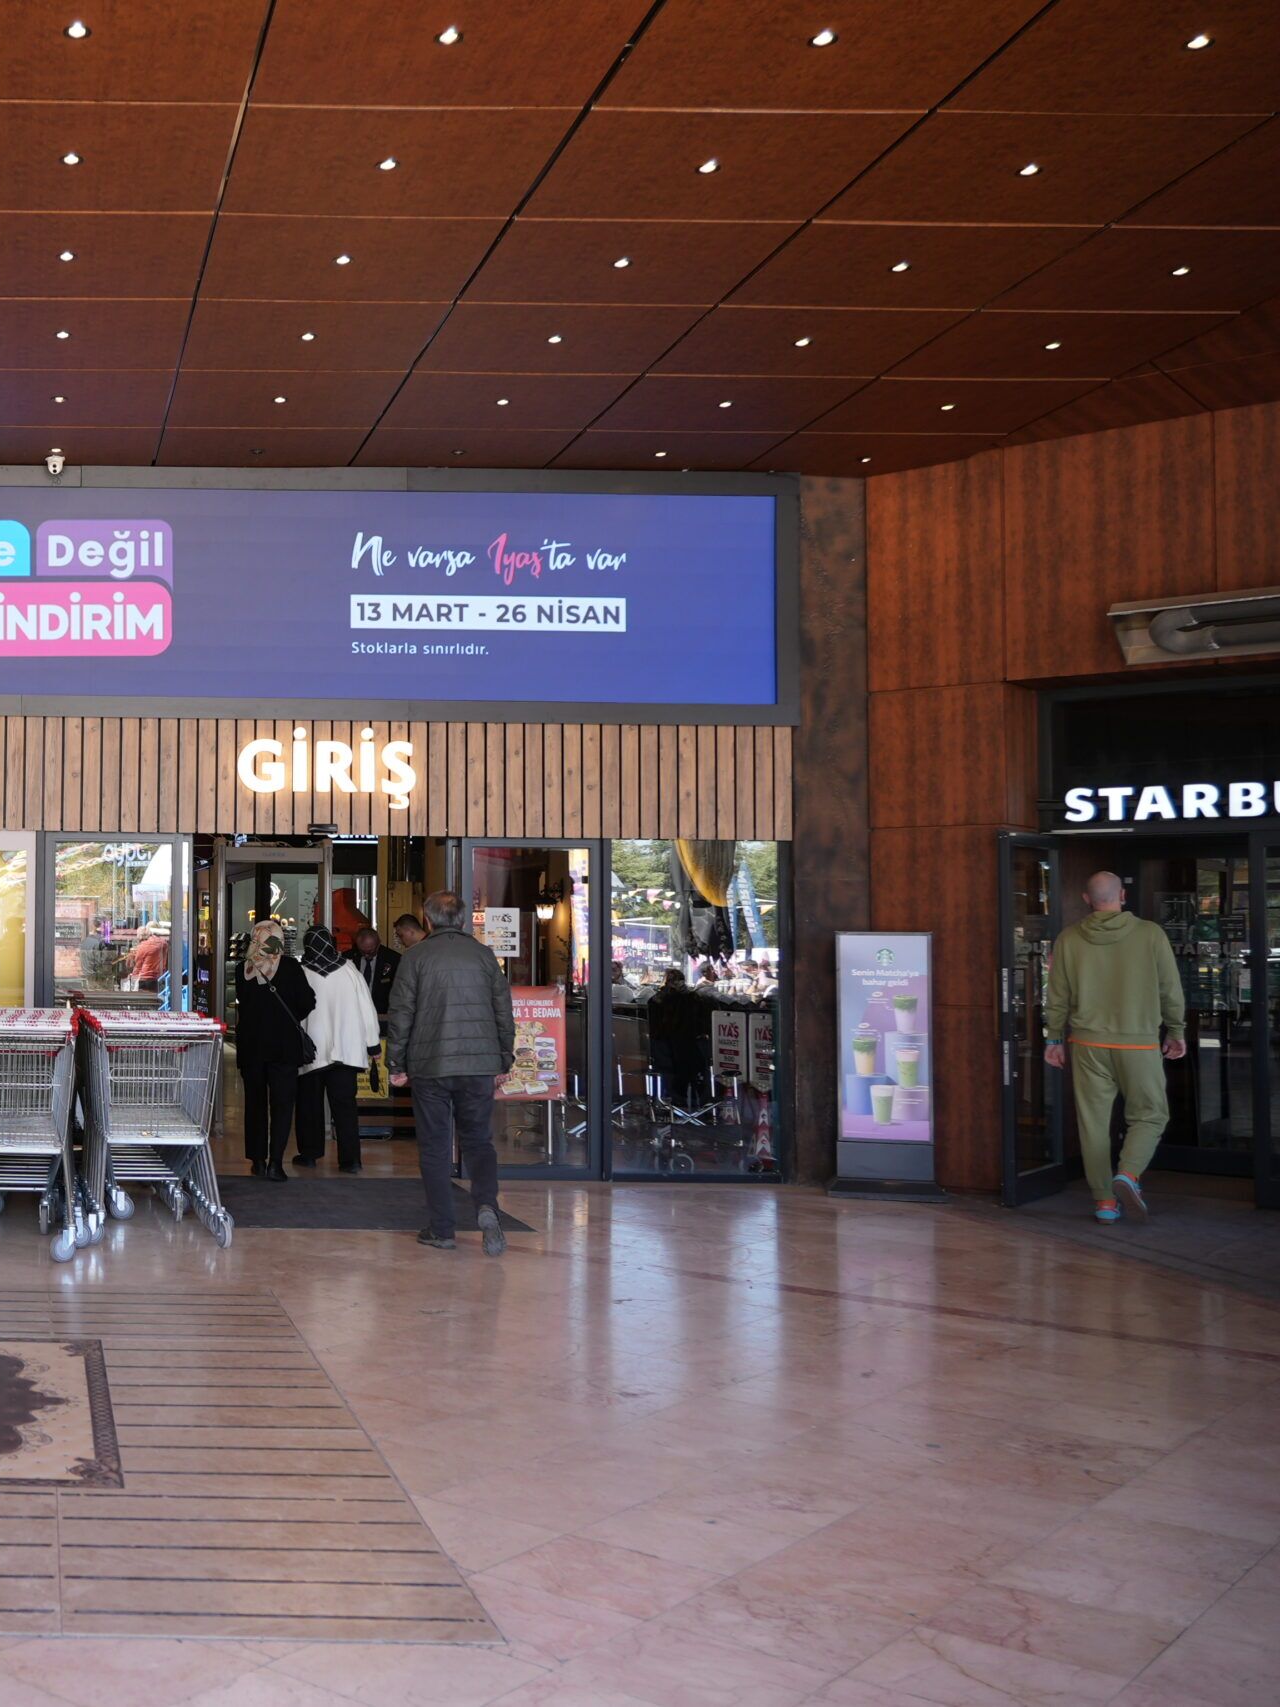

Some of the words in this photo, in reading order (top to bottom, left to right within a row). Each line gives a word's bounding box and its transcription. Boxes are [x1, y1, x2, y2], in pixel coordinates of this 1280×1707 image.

[47, 530, 163, 579] Değil
[351, 532, 397, 577] Ne
[407, 545, 475, 577] varsa
[586, 548, 627, 571] var
[356, 602, 382, 622] 13
[392, 603, 469, 623] MART
[496, 603, 527, 623] 26
[537, 599, 621, 625] NİSAN
[351, 641, 417, 655] Stoklarla
[237, 726, 417, 810] GİRİŞ
[1064, 780, 1280, 822] STARB
[523, 1007, 530, 1018] 1
[532, 1007, 562, 1018] BEDAVA
